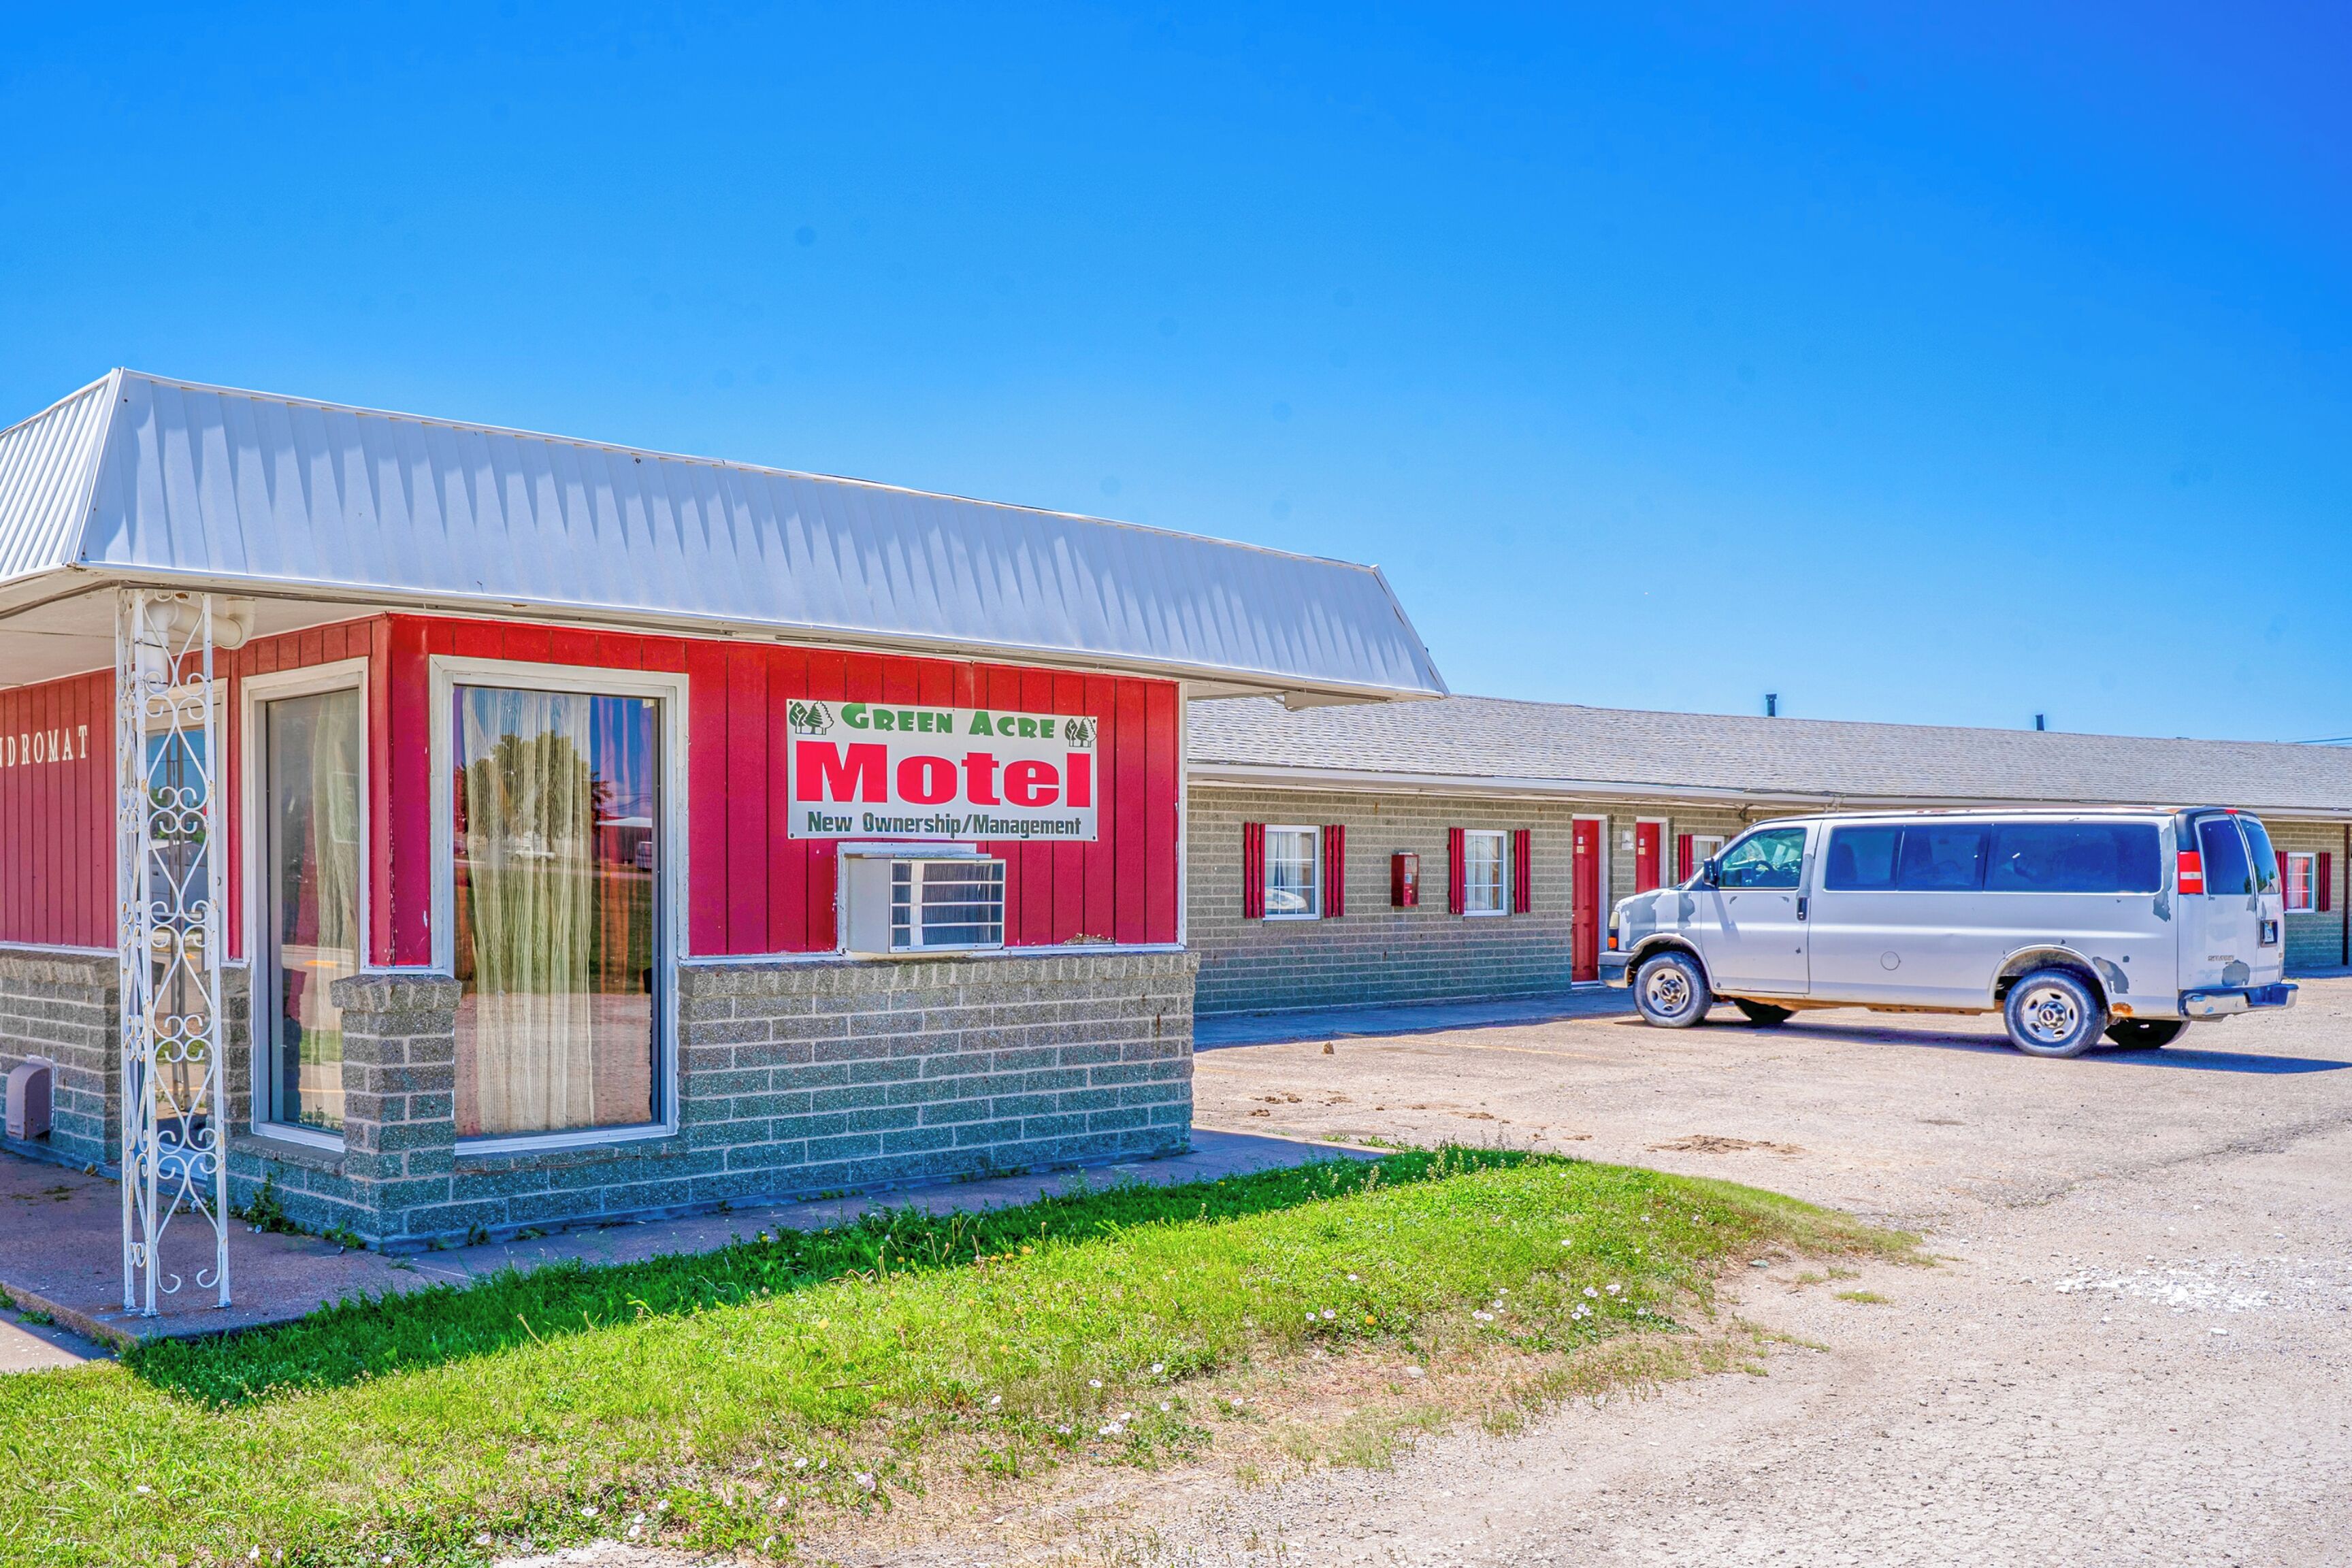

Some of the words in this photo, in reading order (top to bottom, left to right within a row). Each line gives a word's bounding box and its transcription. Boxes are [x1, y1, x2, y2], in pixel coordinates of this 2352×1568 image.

[840, 703, 953, 734] GREEN
[968, 711, 1056, 739] ACRE
[796, 740, 1091, 808] Motel
[808, 811, 853, 832] New
[862, 812, 1081, 839] Ownership/Management
